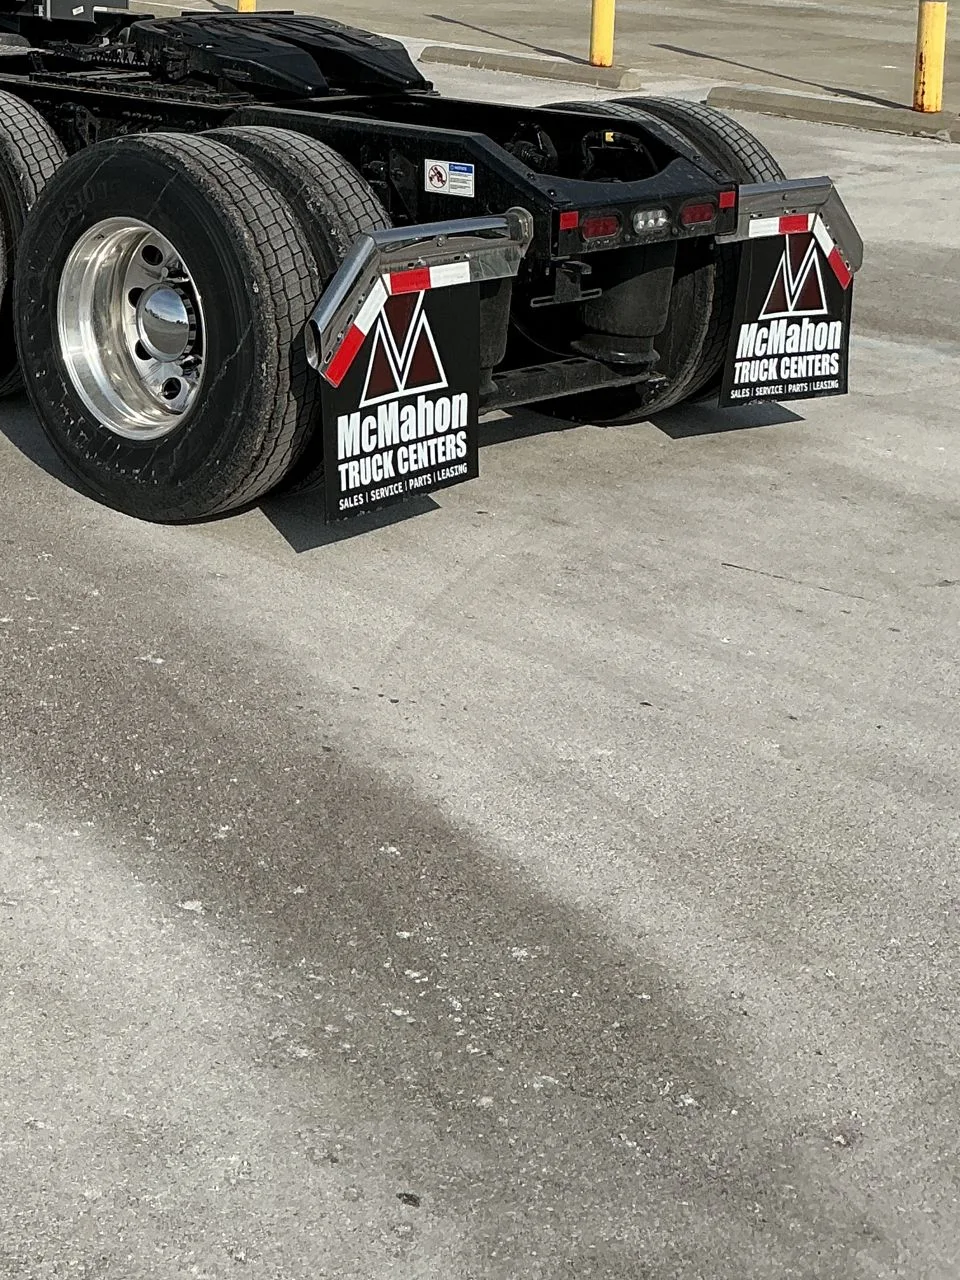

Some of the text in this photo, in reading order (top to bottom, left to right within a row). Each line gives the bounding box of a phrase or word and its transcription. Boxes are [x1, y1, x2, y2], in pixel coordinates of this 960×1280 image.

[736, 318, 842, 359] McMahon
[730, 379, 839, 399] SALES SERVICE PARTS LEASING
[734, 352, 839, 384] TRUCK CENTERS
[337, 392, 468, 460] McMahon
[338, 431, 467, 492] TRUCK CENTERS
[339, 462, 468, 511] SALES SERVICE PARTS LEASING
